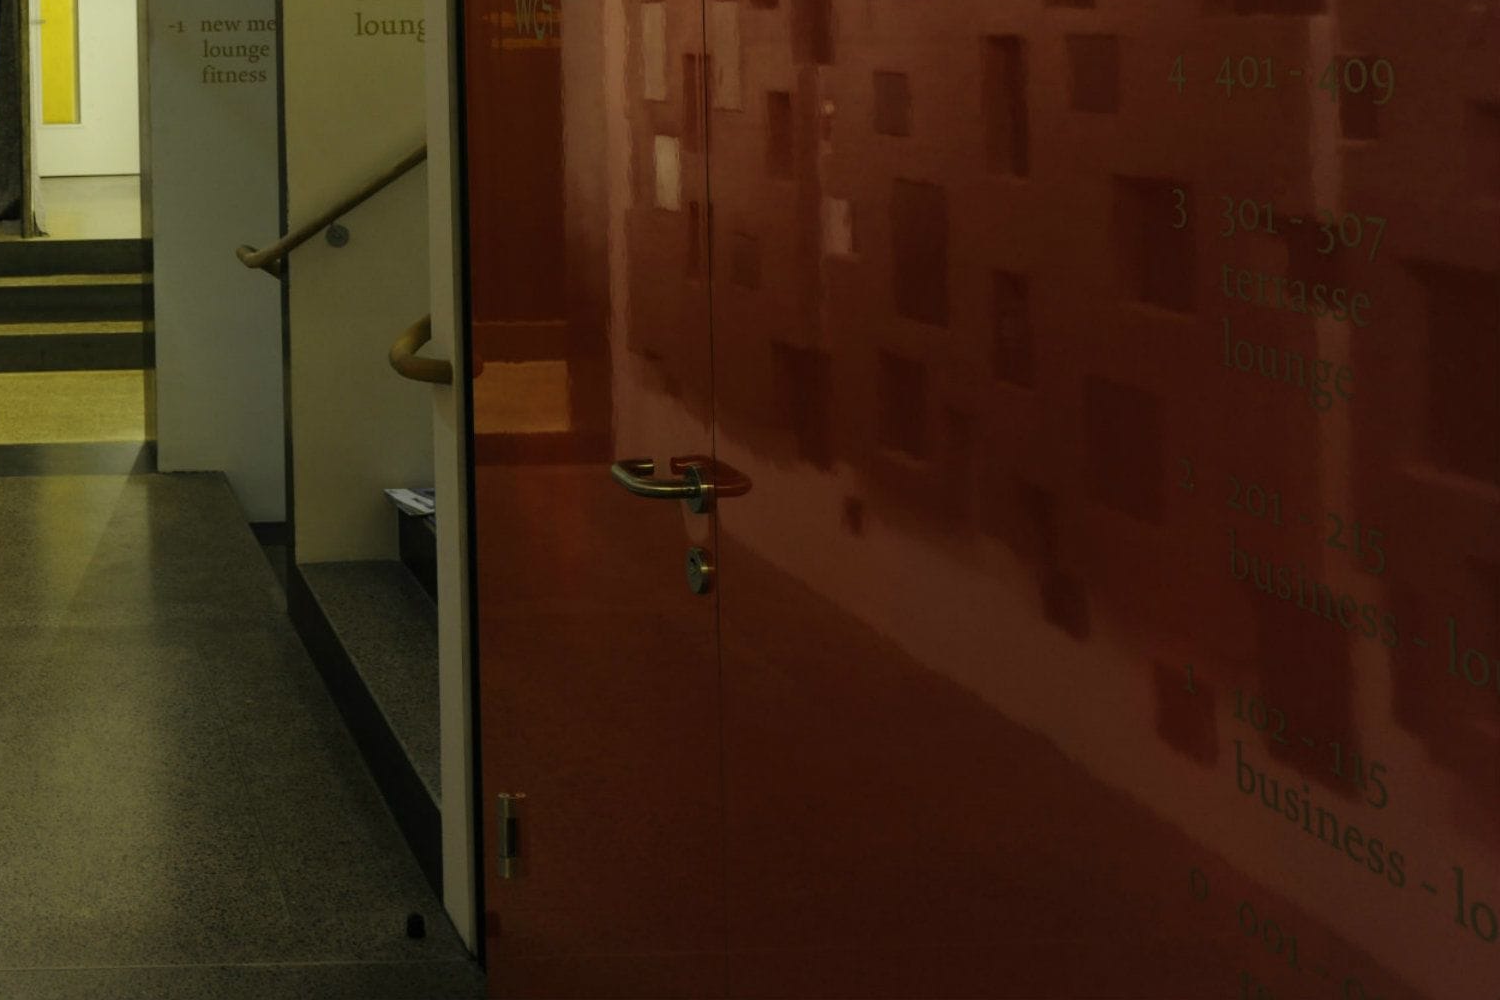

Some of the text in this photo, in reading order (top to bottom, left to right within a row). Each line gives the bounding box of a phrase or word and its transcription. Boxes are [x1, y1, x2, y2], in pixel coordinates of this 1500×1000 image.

[201, 19, 241, 33] new
[202, 39, 270, 63] lounge
[202, 65, 267, 84] fitness
[1168, 55, 1187, 96] 4
[1215, 56, 1277, 98] 401
[1316, 58, 1396, 105] 409
[1172, 187, 1188, 230] 3
[1220, 195, 1277, 238] 301
[1316, 203, 1388, 264] 307
[1220, 263, 1372, 328] terrasse
[1222, 316, 1355, 416] lounge
[1176, 456, 1196, 492] 2
[1225, 474, 1283, 529] 201
[1325, 509, 1387, 575] 215
[1227, 527, 1399, 649] business
[1232, 686, 1288, 745] 102
[1328, 741, 1389, 810] 115
[1234, 739, 1407, 890] business
